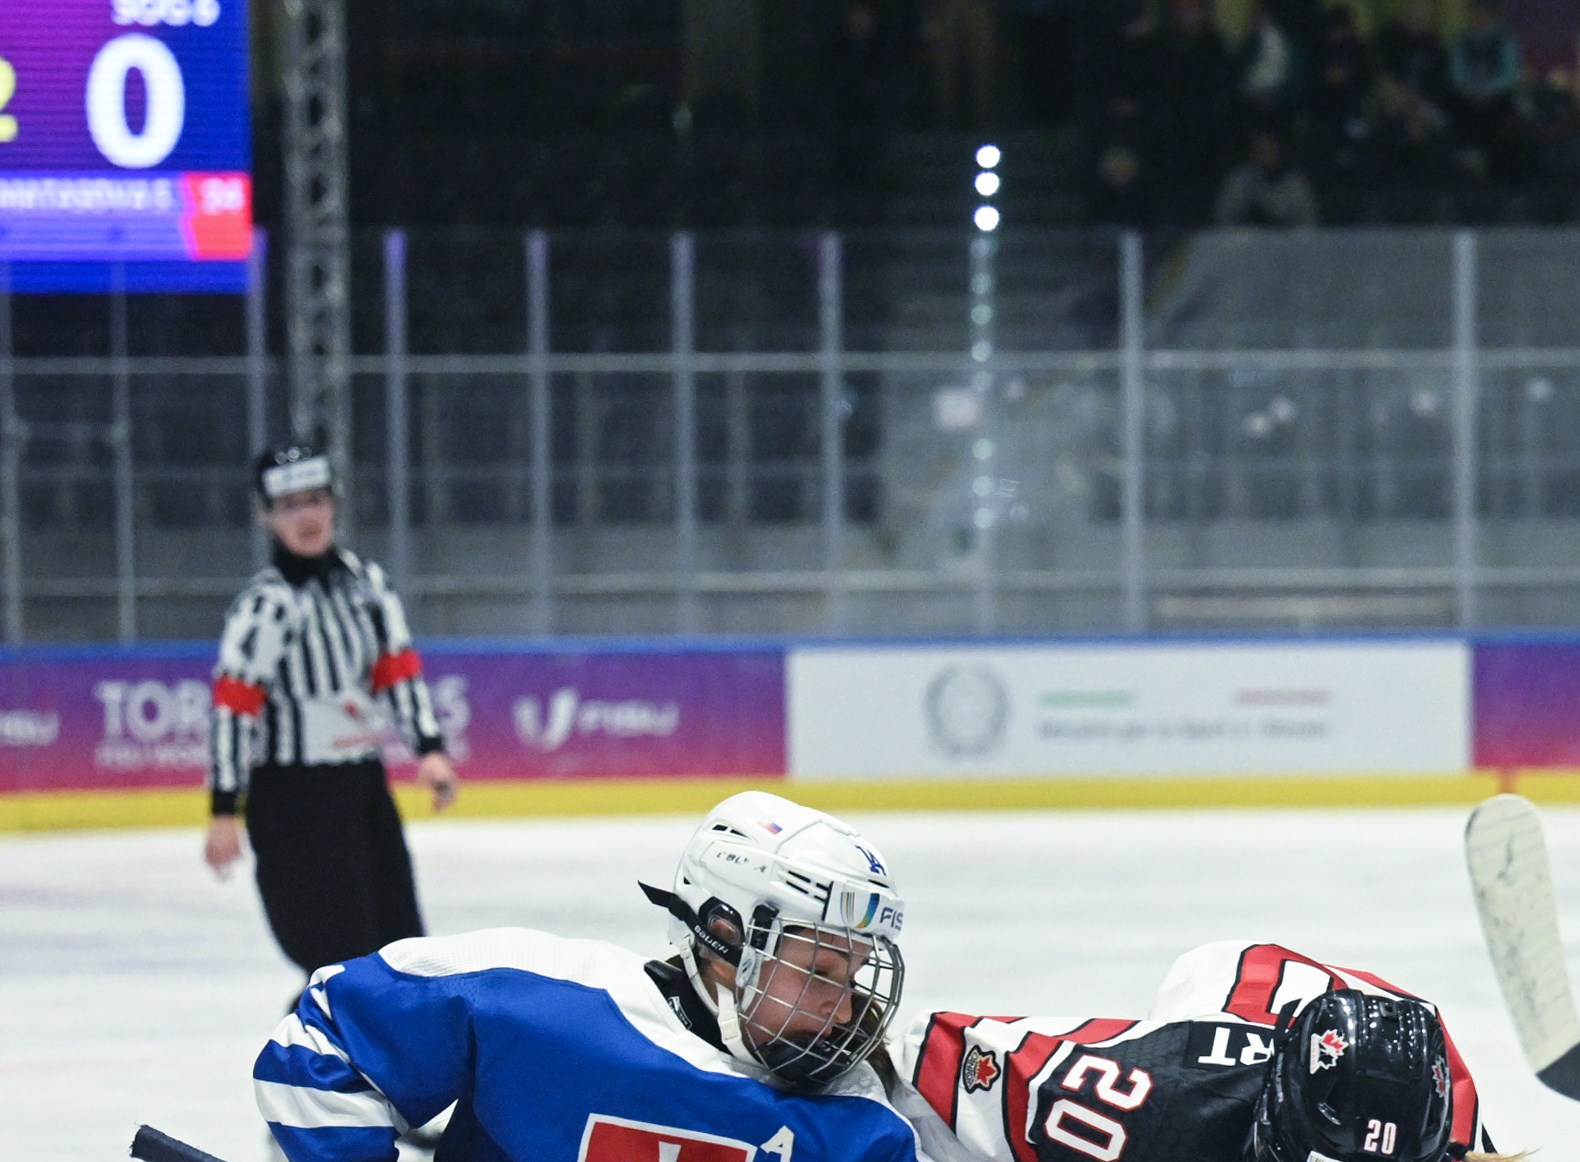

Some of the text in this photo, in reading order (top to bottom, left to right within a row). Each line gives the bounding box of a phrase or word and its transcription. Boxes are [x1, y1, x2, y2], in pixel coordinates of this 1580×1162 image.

[86, 33, 185, 169] 0
[879, 905, 904, 933] FIS
[1044, 1053, 1154, 1162] 20
[1363, 1118, 1398, 1156] 20
